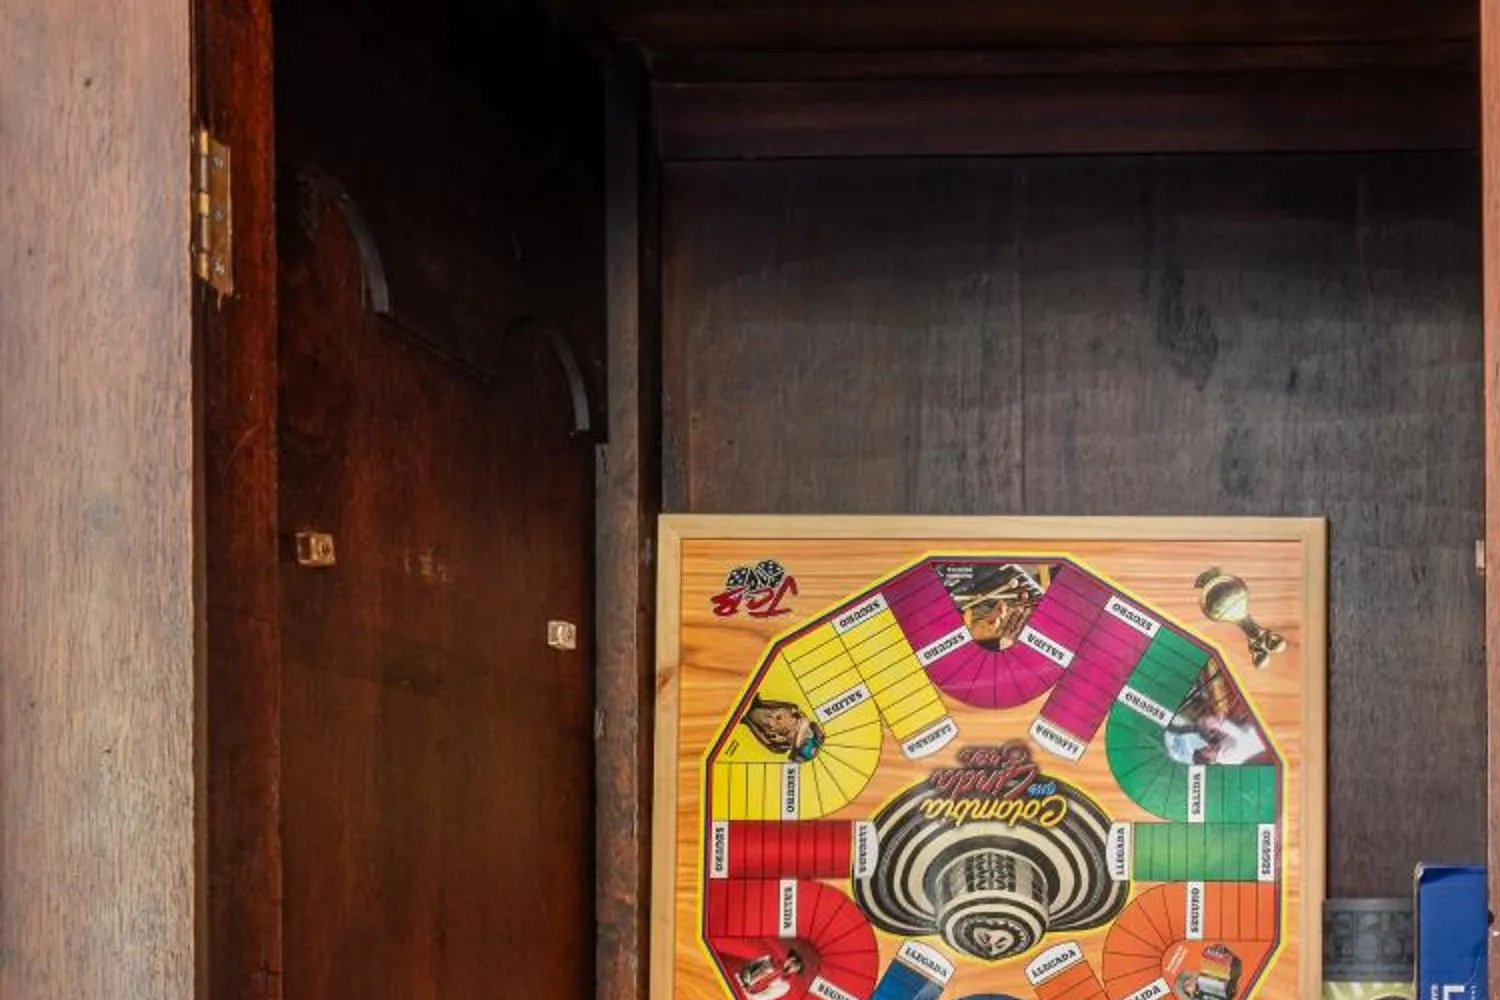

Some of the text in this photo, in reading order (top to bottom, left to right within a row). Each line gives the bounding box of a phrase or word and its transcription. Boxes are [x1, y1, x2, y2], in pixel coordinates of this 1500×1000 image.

[838, 594, 883, 632] SEGURO
[1109, 598, 1156, 633] SEGURO
[921, 629, 968, 664] SEGURO
[1025, 632, 1070, 664] SALIDA
[822, 687, 867, 720] SALIDA
[1124, 689, 1169, 723] SEGURO
[785, 767, 795, 814] SEGURO
[1191, 770, 1202, 816] SALIDA
[920, 794, 1067, 828] Colombia
[714, 826, 725, 874] SEGURO
[1262, 827, 1272, 875] SEGURO
[783, 884, 794, 930] SALIDA
[1190, 885, 1201, 933] SEGURO
[904, 944, 949, 978] LLEGADA
[1032, 947, 1078, 980] LLEGADA
